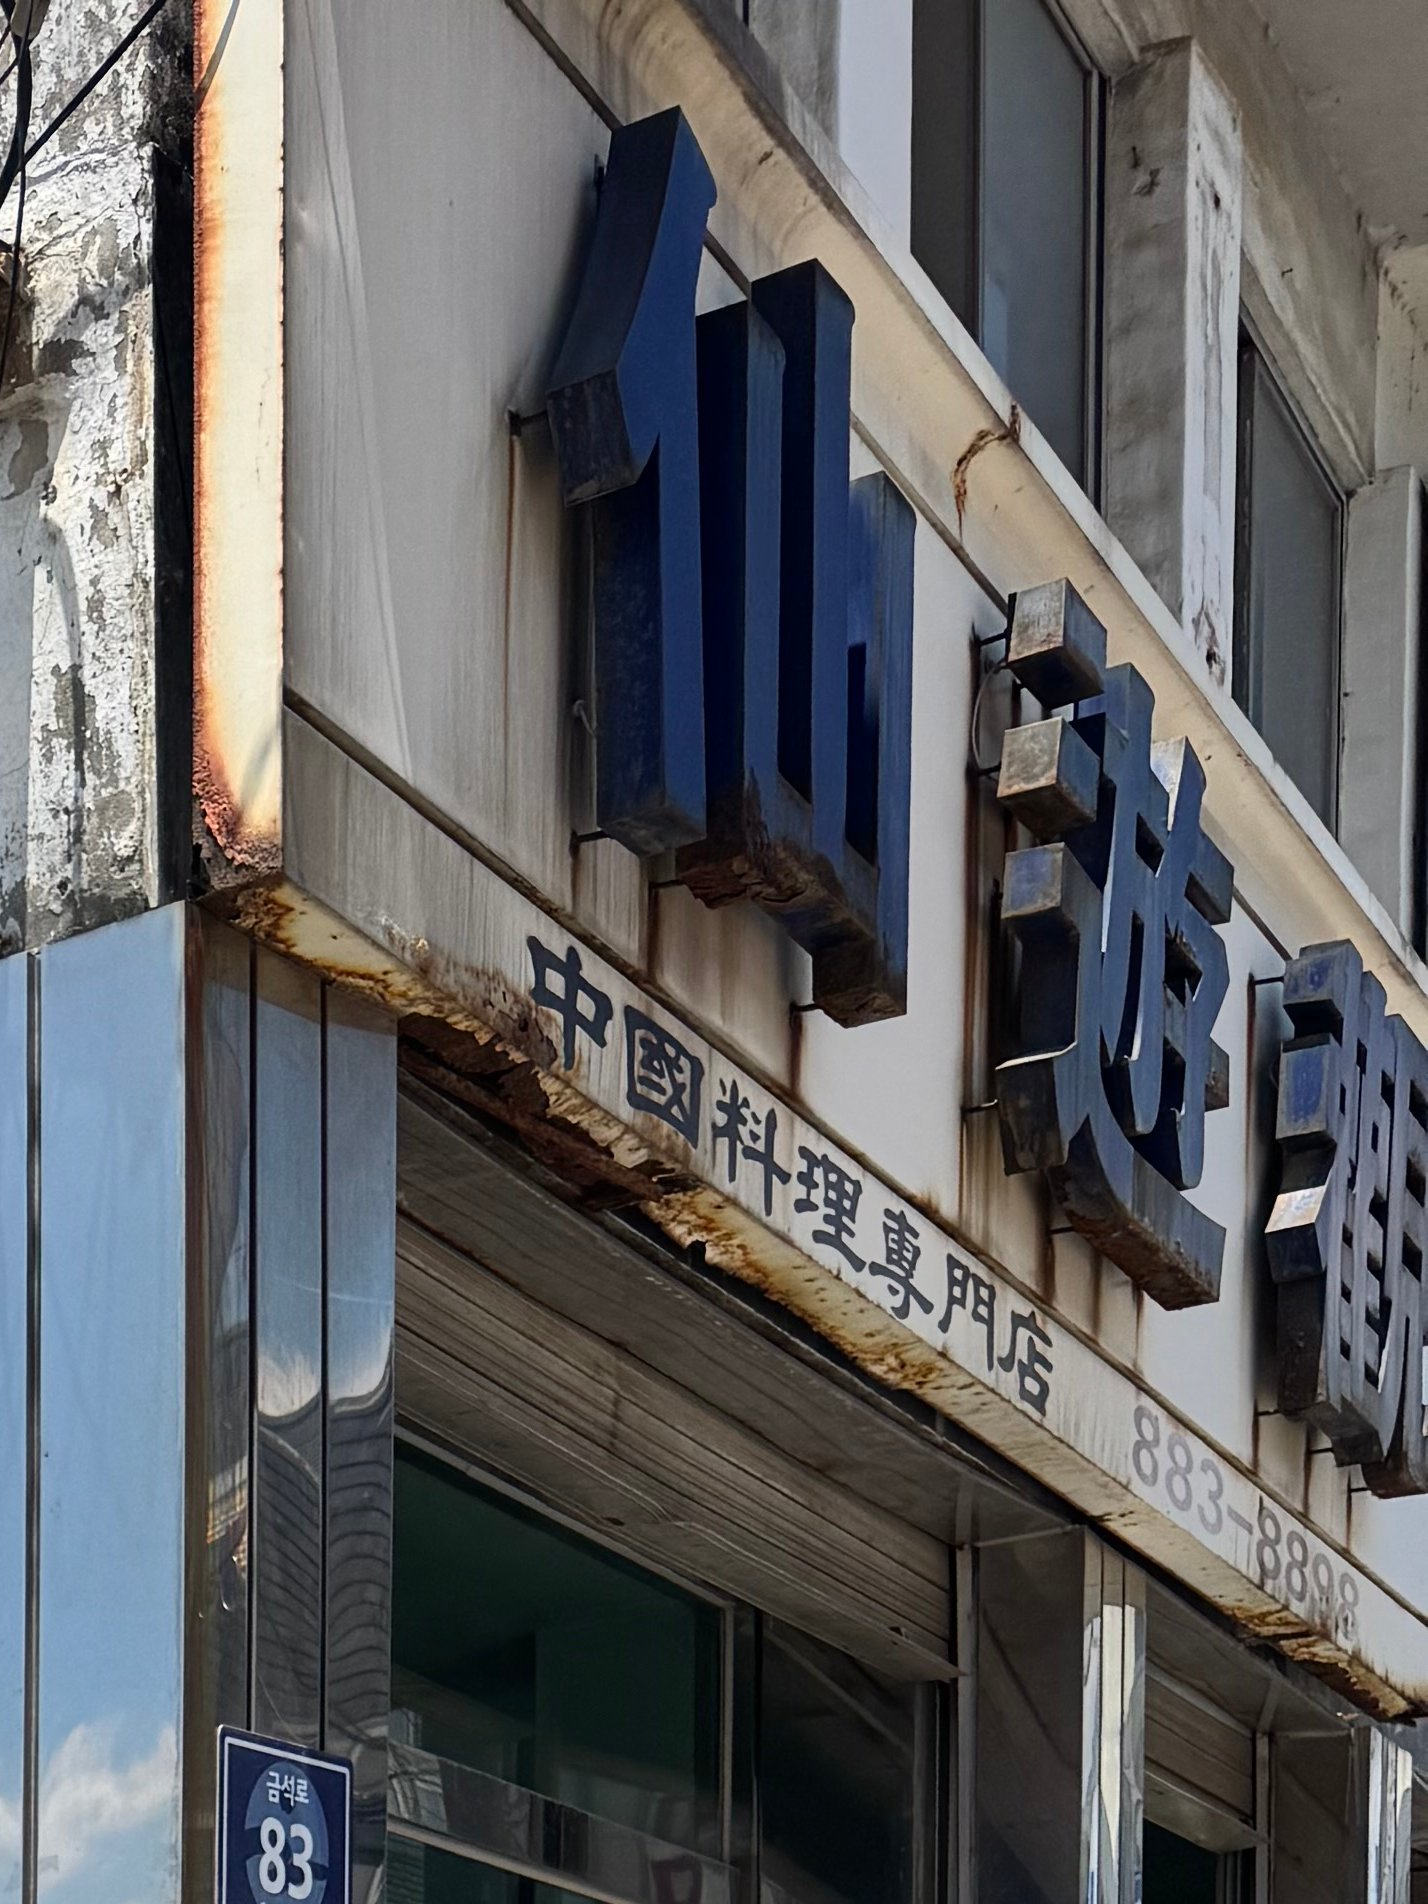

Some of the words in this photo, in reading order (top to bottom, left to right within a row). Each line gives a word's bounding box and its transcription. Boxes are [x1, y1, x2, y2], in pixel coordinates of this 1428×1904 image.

[526, 934, 1057, 1417] 中國料理專門店
[265, 1770, 310, 1807] 금석로
[258, 1816, 314, 1900] 83
